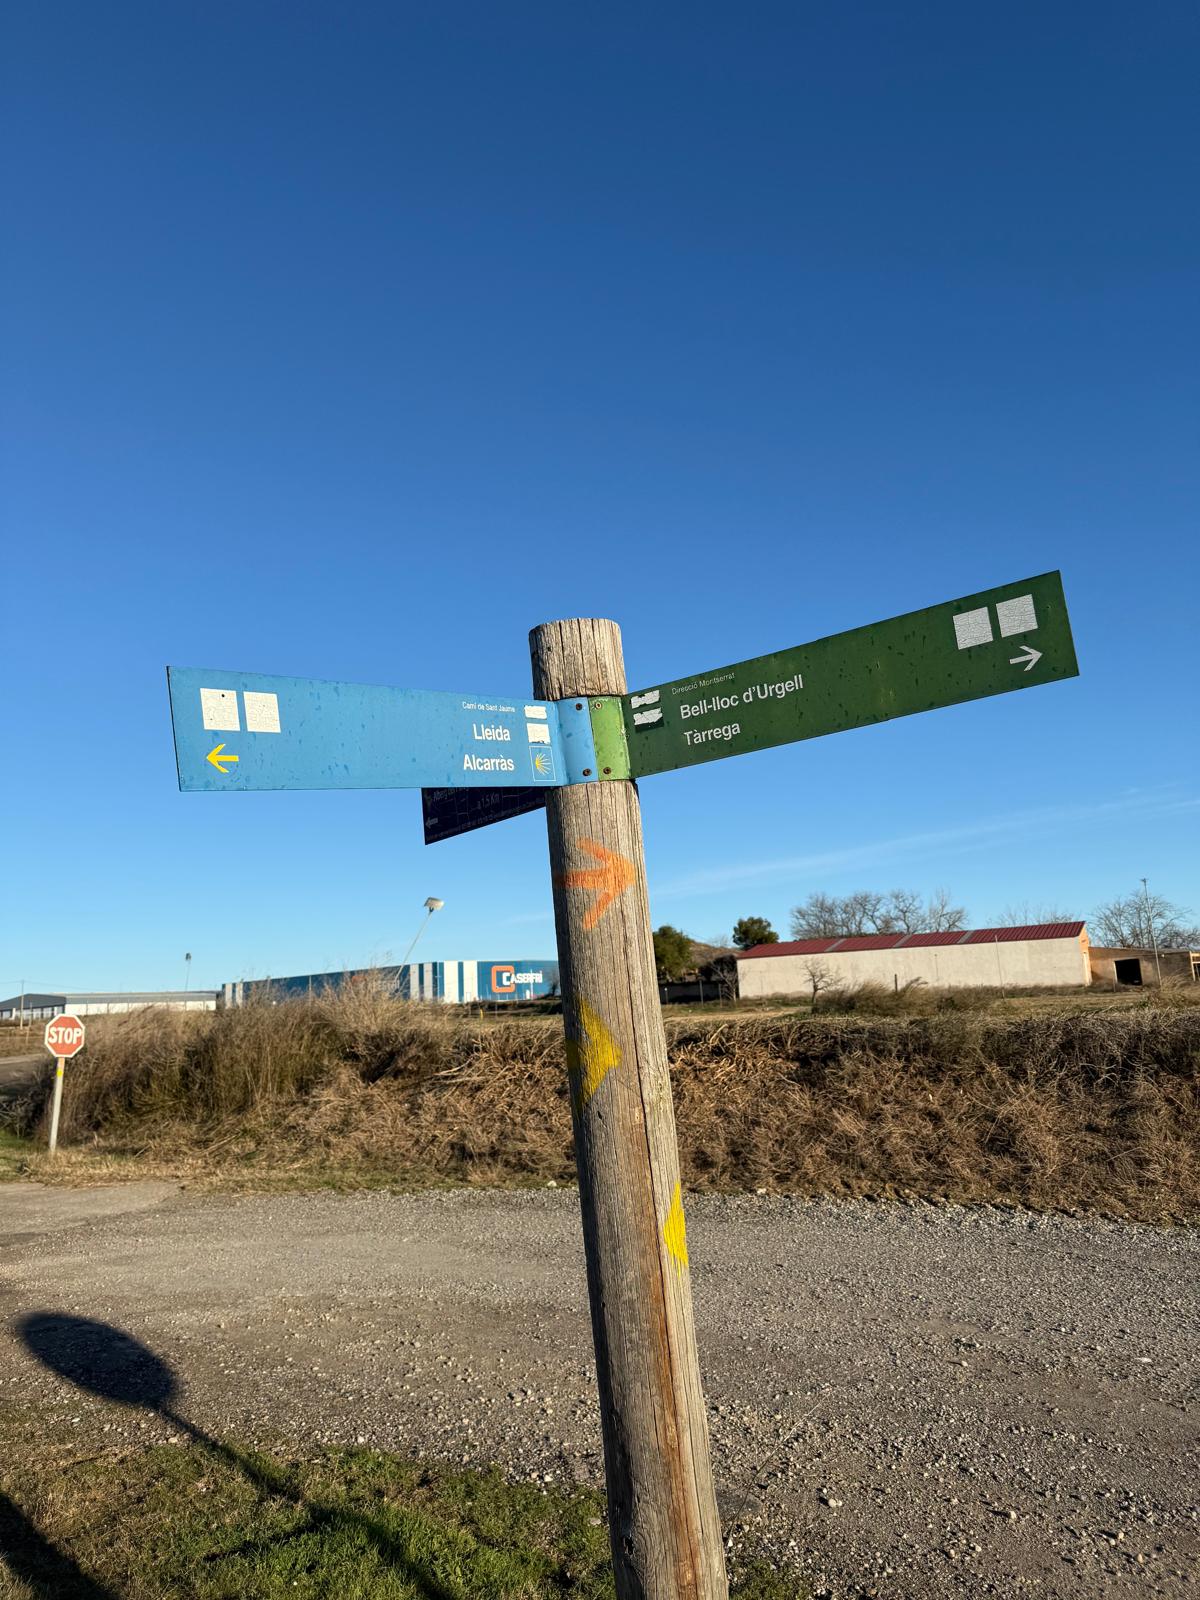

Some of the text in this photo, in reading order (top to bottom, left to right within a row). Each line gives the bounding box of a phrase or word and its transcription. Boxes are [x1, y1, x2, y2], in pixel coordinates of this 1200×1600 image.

[671, 672, 735, 695] Direcció Montserrat
[477, 703, 485, 711] de
[485, 703, 498, 711] Sant
[499, 704, 516, 713] Jaume
[680, 694, 739, 719] Bell-lloc
[473, 723, 511, 741] Lleida
[683, 722, 741, 746] Tàrrega
[463, 753, 515, 771] Alcarràs
[48, 1026, 82, 1045] STOP
